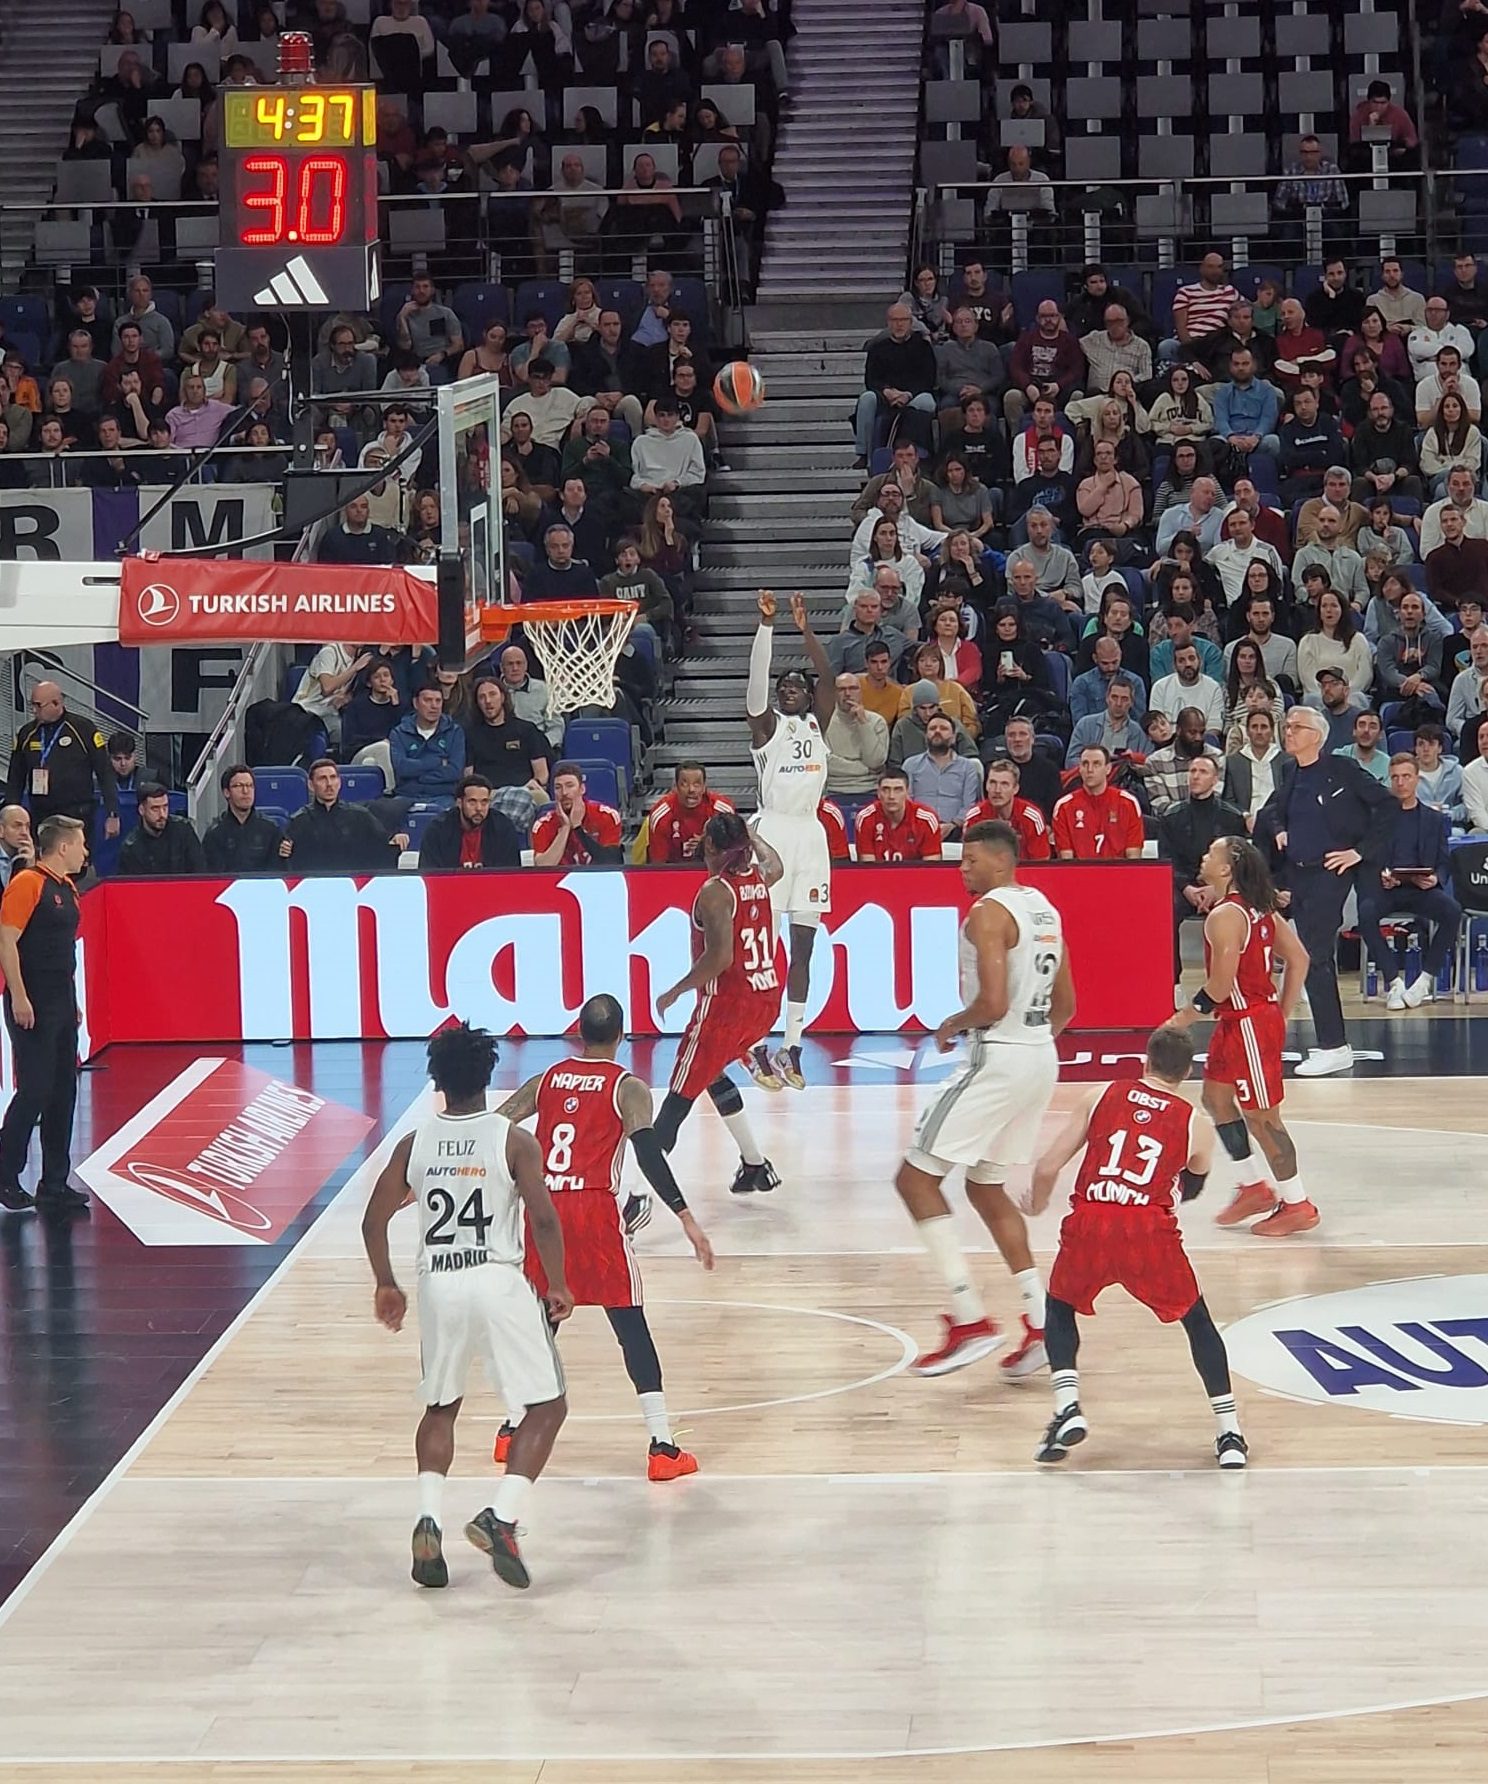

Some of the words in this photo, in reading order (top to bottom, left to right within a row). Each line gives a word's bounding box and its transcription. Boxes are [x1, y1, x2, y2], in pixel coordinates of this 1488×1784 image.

[256, 95, 354, 142] 4:37
[241, 154, 348, 247] 3.0
[616, 584, 646, 599] GANT
[189, 594, 288, 614] TURKISH
[294, 593, 396, 613] AIRLINES
[792, 739, 812, 759] 30
[1095, 834, 1105, 853] 7
[741, 927, 773, 971] 31
[550, 1073, 606, 1092] NAPIER
[1236, 1079, 1250, 1102] 3
[1127, 1089, 1171, 1111] OBST
[187, 1124, 285, 1190] TURKISH
[236, 1080, 326, 1146] AIRLINES
[438, 1139, 476, 1157] FELIZ
[547, 1123, 575, 1172] 8
[1098, 1129, 1163, 1186] 13
[426, 1166, 487, 1177] AUTOHERO
[425, 1187, 494, 1246] 24
